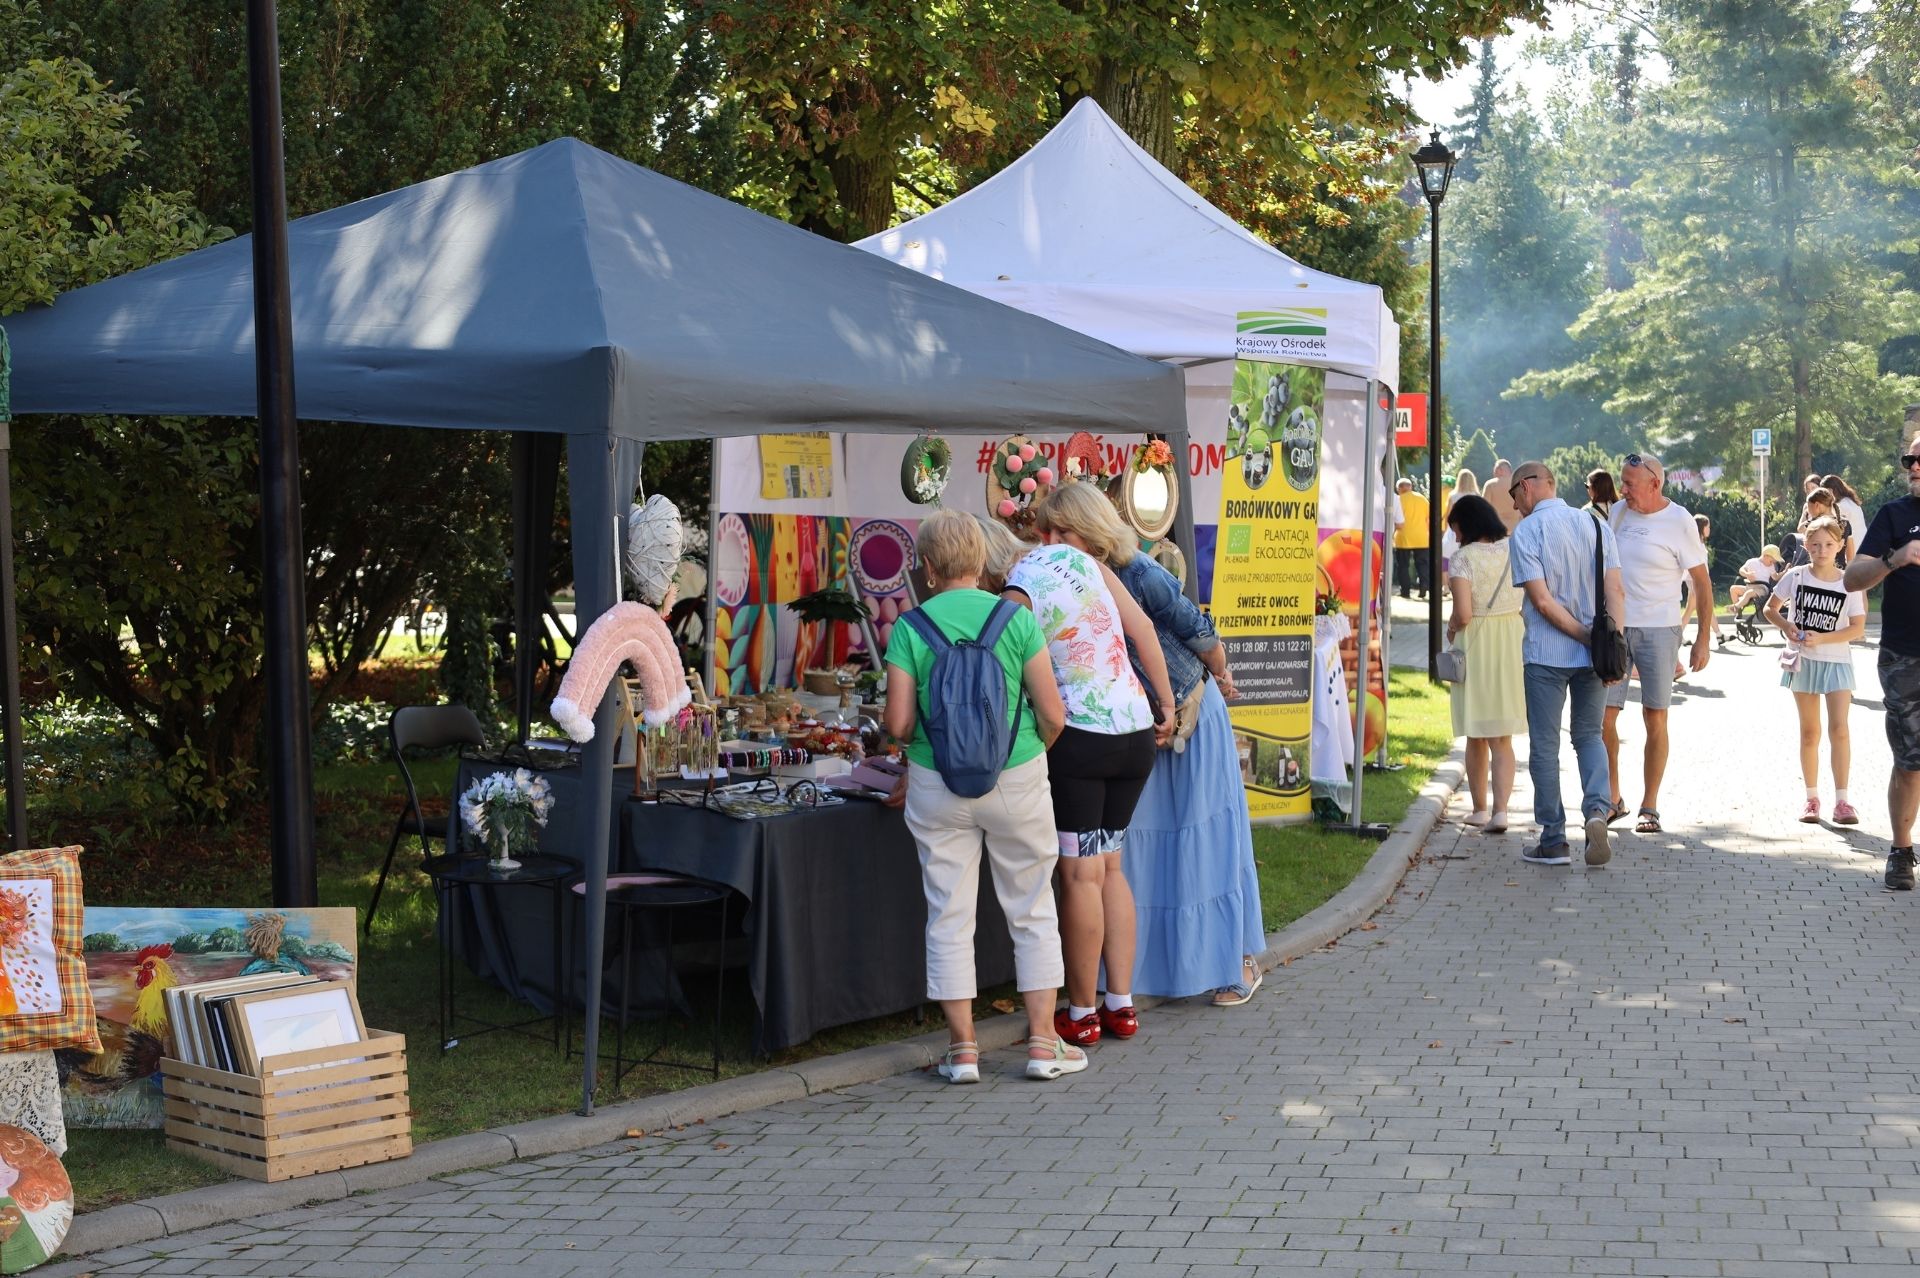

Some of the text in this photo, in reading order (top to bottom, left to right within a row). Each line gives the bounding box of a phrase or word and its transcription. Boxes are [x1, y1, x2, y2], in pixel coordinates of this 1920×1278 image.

[1236, 337, 1326, 349] Krajowy Ośrodek
[1237, 347, 1279, 355] Wsparcia
[1757, 431, 1766, 444] P
[1291, 447, 1314, 468] GAJ
[1226, 495, 1301, 519] BORÓWKOWY
[1264, 529, 1309, 545] PLANTACJA
[1255, 547, 1314, 559] EKOLOGICZNA
[1223, 574, 1246, 583] UPRAWA
[1247, 573, 1252, 583] Z
[1237, 592, 1299, 608] ŚWIEŻE OWOCE
[1803, 592, 1842, 615] WANNA
[1219, 615, 1269, 628] PRZETWORY
[1271, 615, 1276, 627] Z
[1804, 611, 1837, 631] ADORED
[1229, 640, 1311, 654] 519 128 087, 513 122 211
[1265, 662, 1277, 670] GAJ
